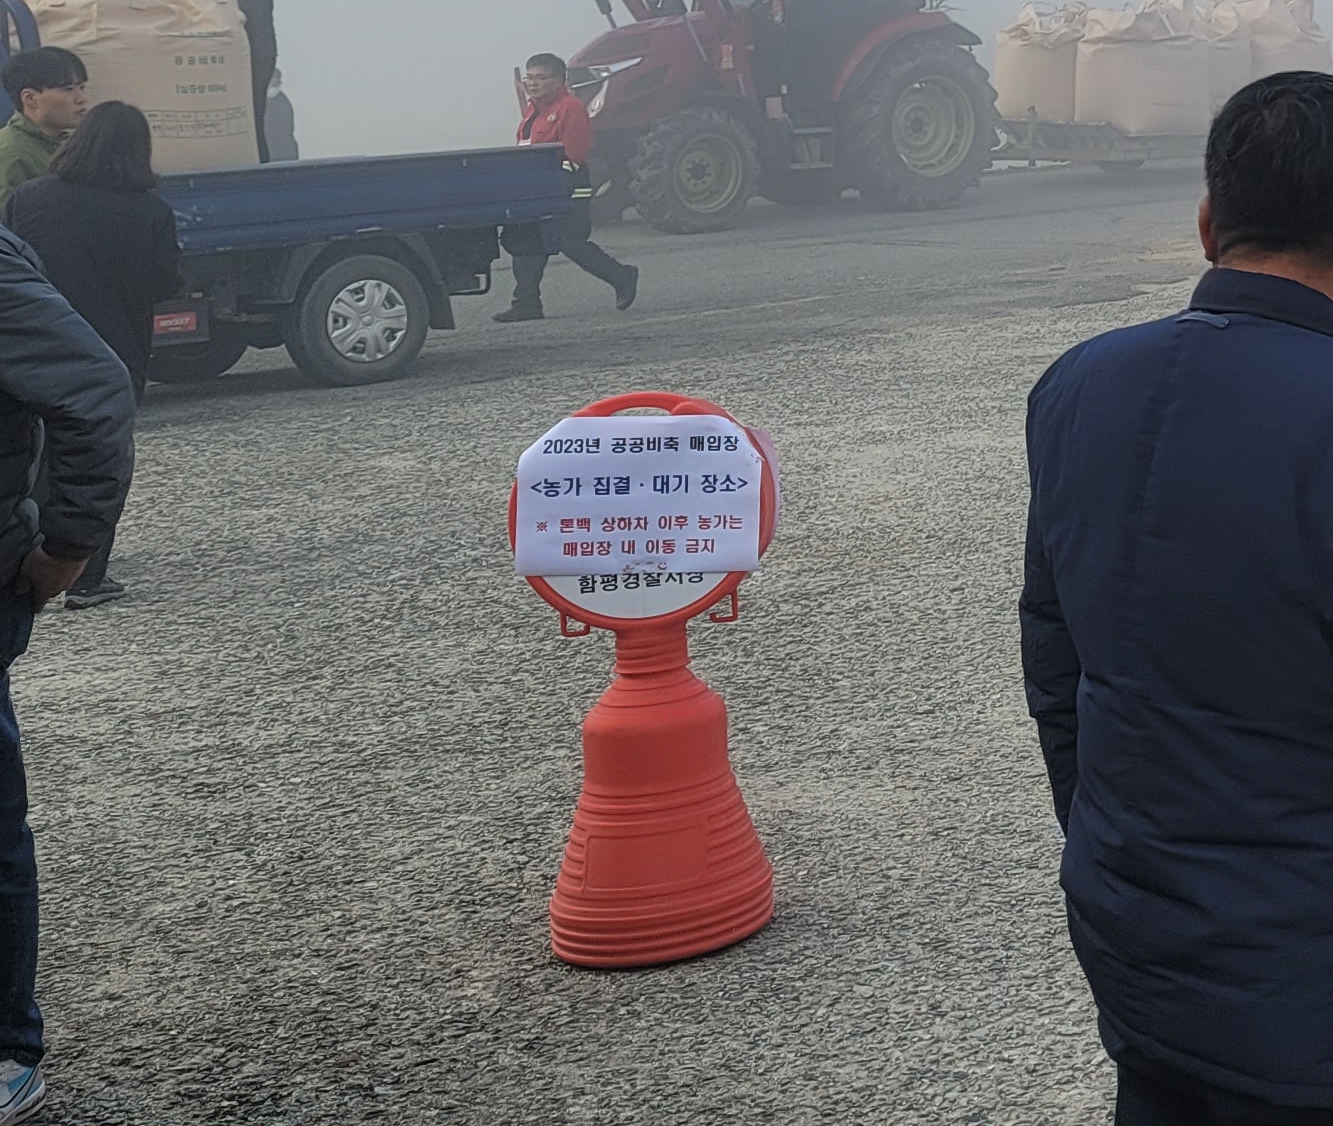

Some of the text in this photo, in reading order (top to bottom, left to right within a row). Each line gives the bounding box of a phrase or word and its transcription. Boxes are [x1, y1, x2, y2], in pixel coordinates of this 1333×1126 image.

[543, 435, 740, 455] 2023년 공공비축 매입장
[530, 477, 583, 497] <농가
[593, 475, 631, 496] 집결
[652, 474, 690, 494] 대기
[700, 474, 749, 493] 장소>
[559, 517, 591, 534] 톤백
[600, 516, 650, 532] 상하차
[657, 515, 689, 531] 이후
[697, 514, 744, 530] 농가는
[563, 538, 716, 558] 매입장 내 이동 금지
